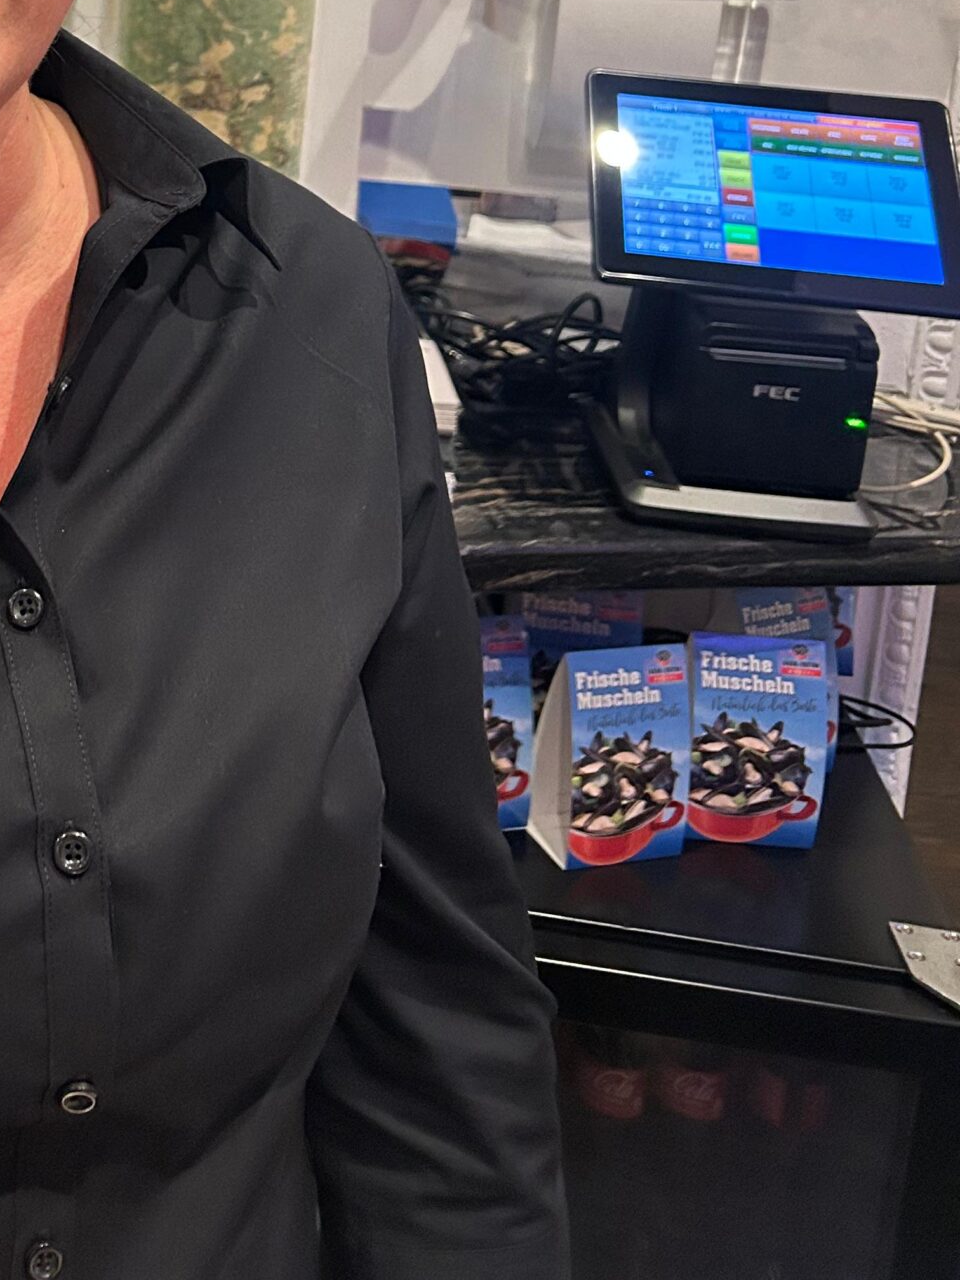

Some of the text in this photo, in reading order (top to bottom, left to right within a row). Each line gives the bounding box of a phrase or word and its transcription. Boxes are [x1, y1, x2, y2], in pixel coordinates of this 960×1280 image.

[753, 384, 801, 402] FEC
[742, 601, 793, 625] Frische
[700, 650, 774, 673] Frische
[575, 668, 641, 690] Frische
[701, 670, 795, 695] Muscheln
[577, 686, 661, 710] Muscheln
